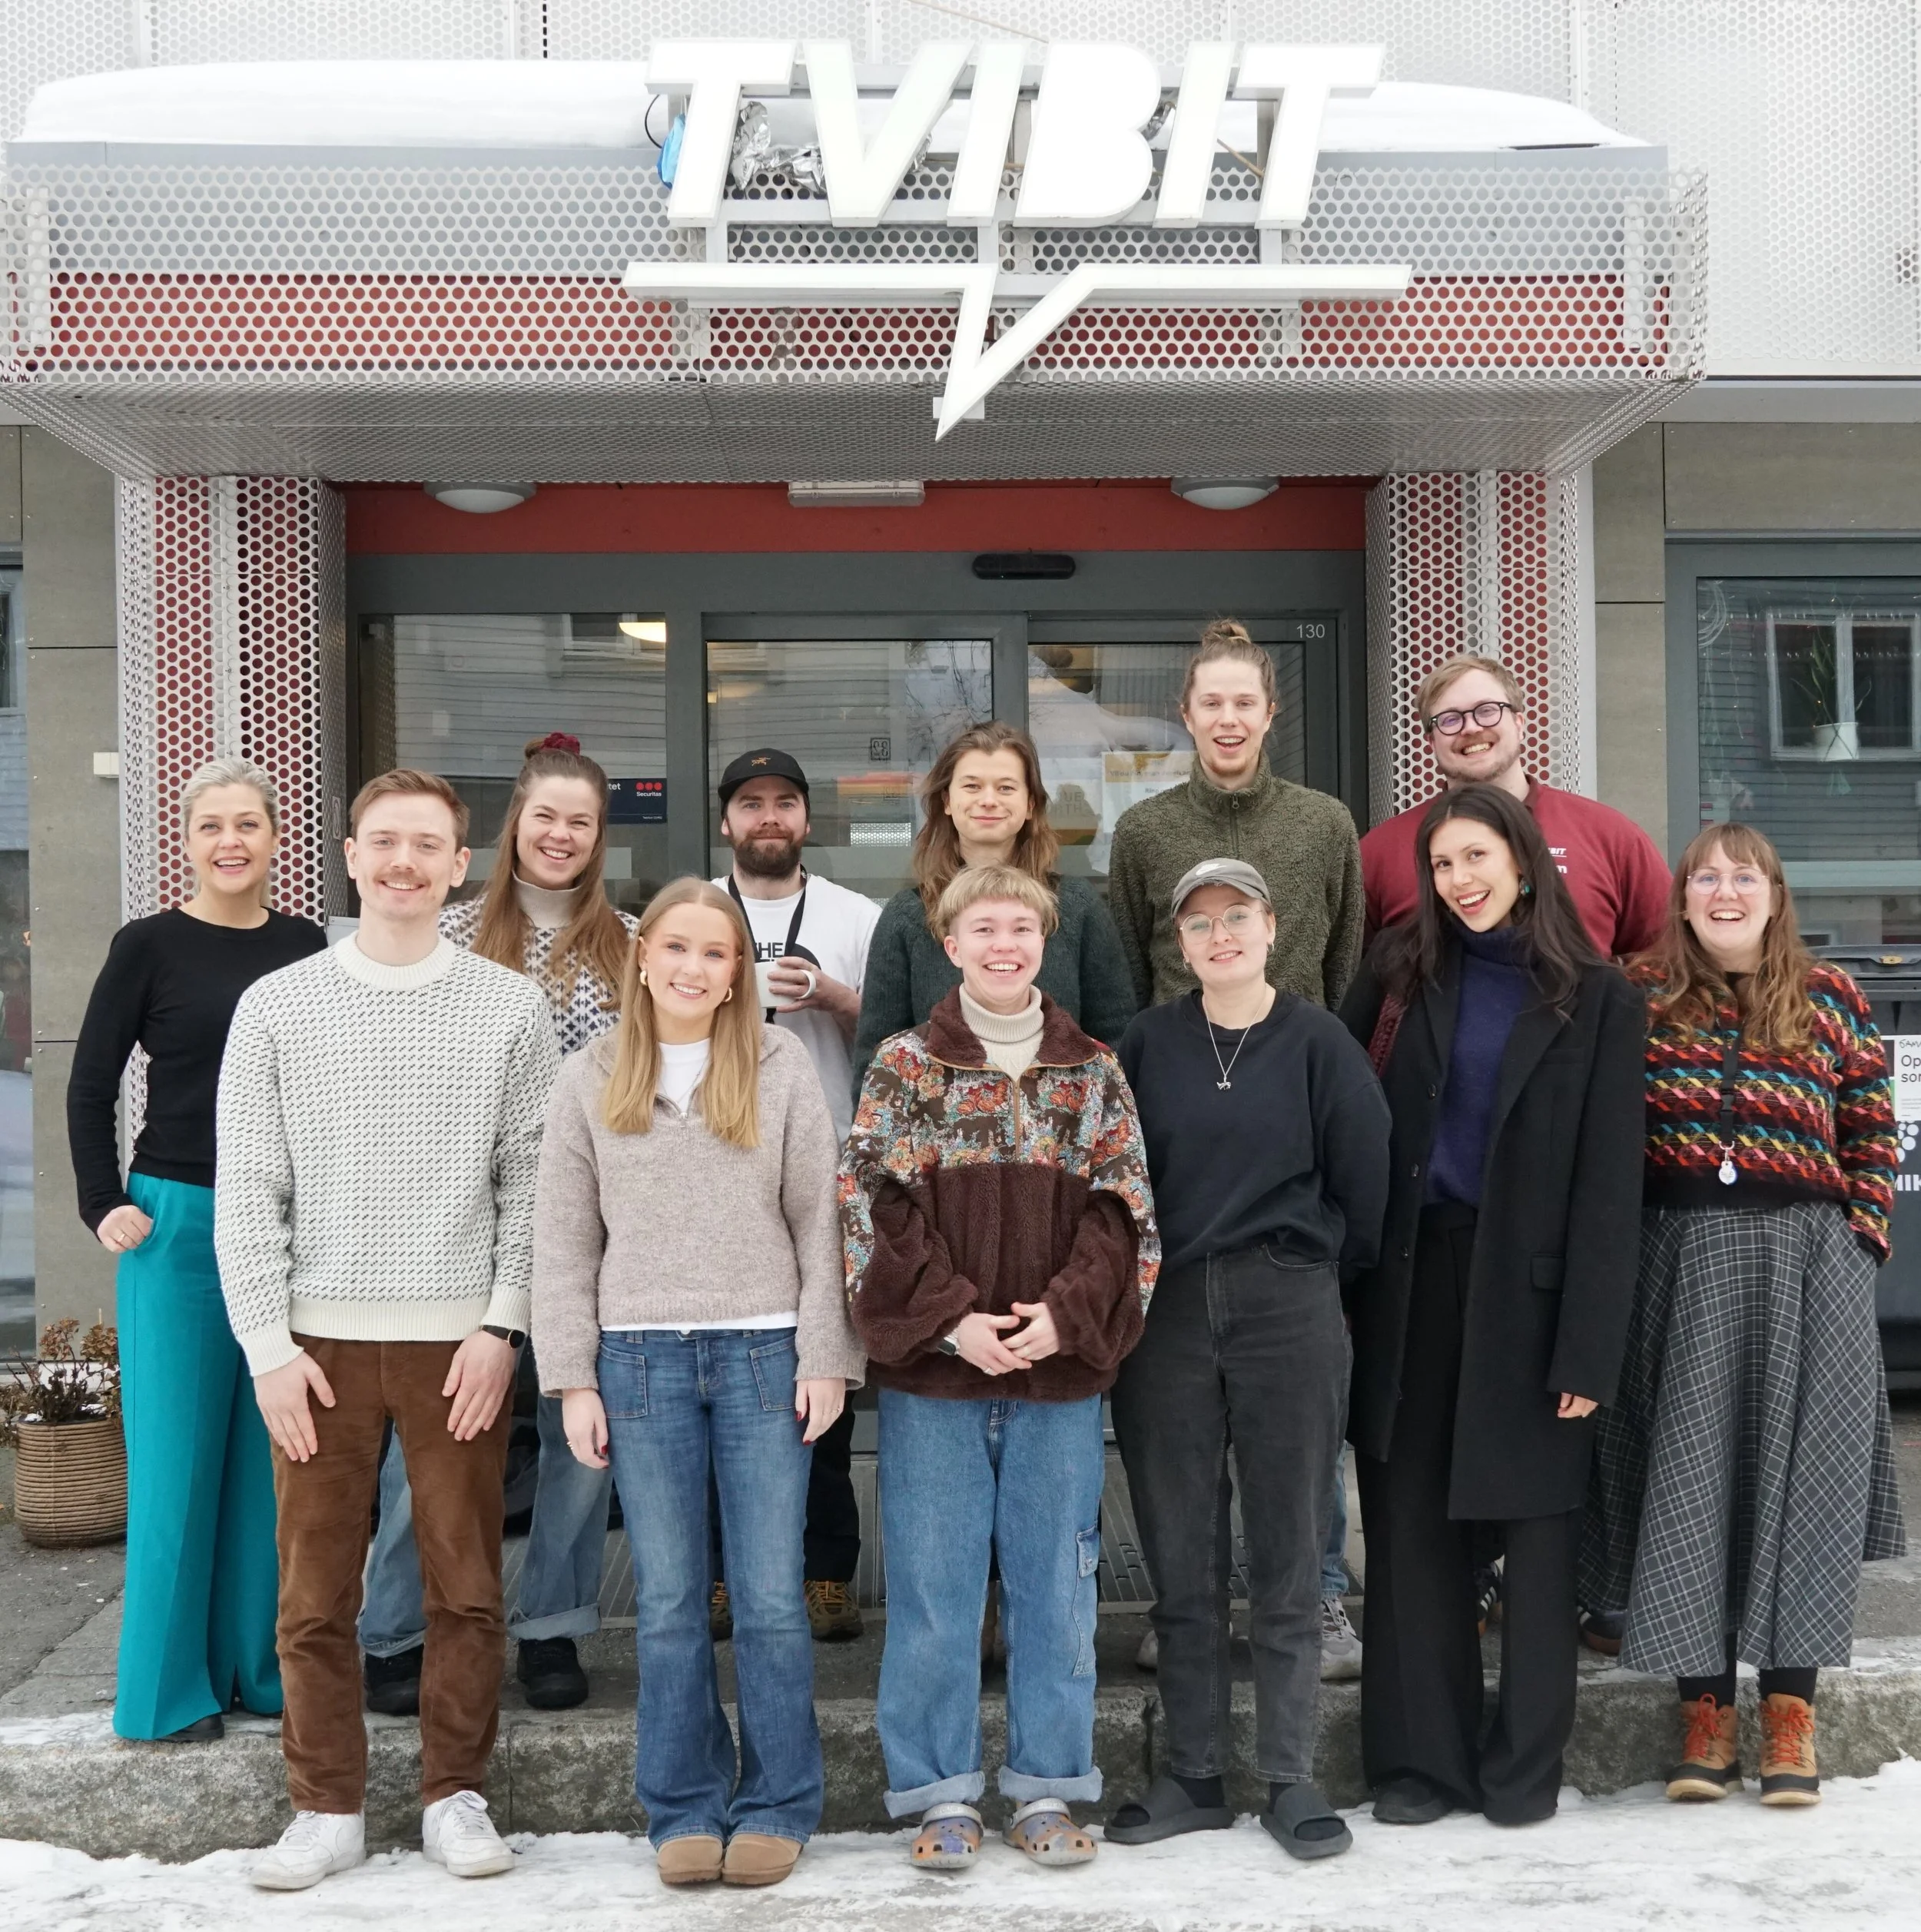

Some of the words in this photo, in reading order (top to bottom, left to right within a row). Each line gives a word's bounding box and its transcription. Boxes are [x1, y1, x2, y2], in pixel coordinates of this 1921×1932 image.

[644, 38, 1383, 229] TVIBIT
[1296, 623, 1325, 639] 130
[609, 782, 621, 791] tet
[755, 941, 784, 958] HE
[1901, 1054, 1921, 1069] Op
